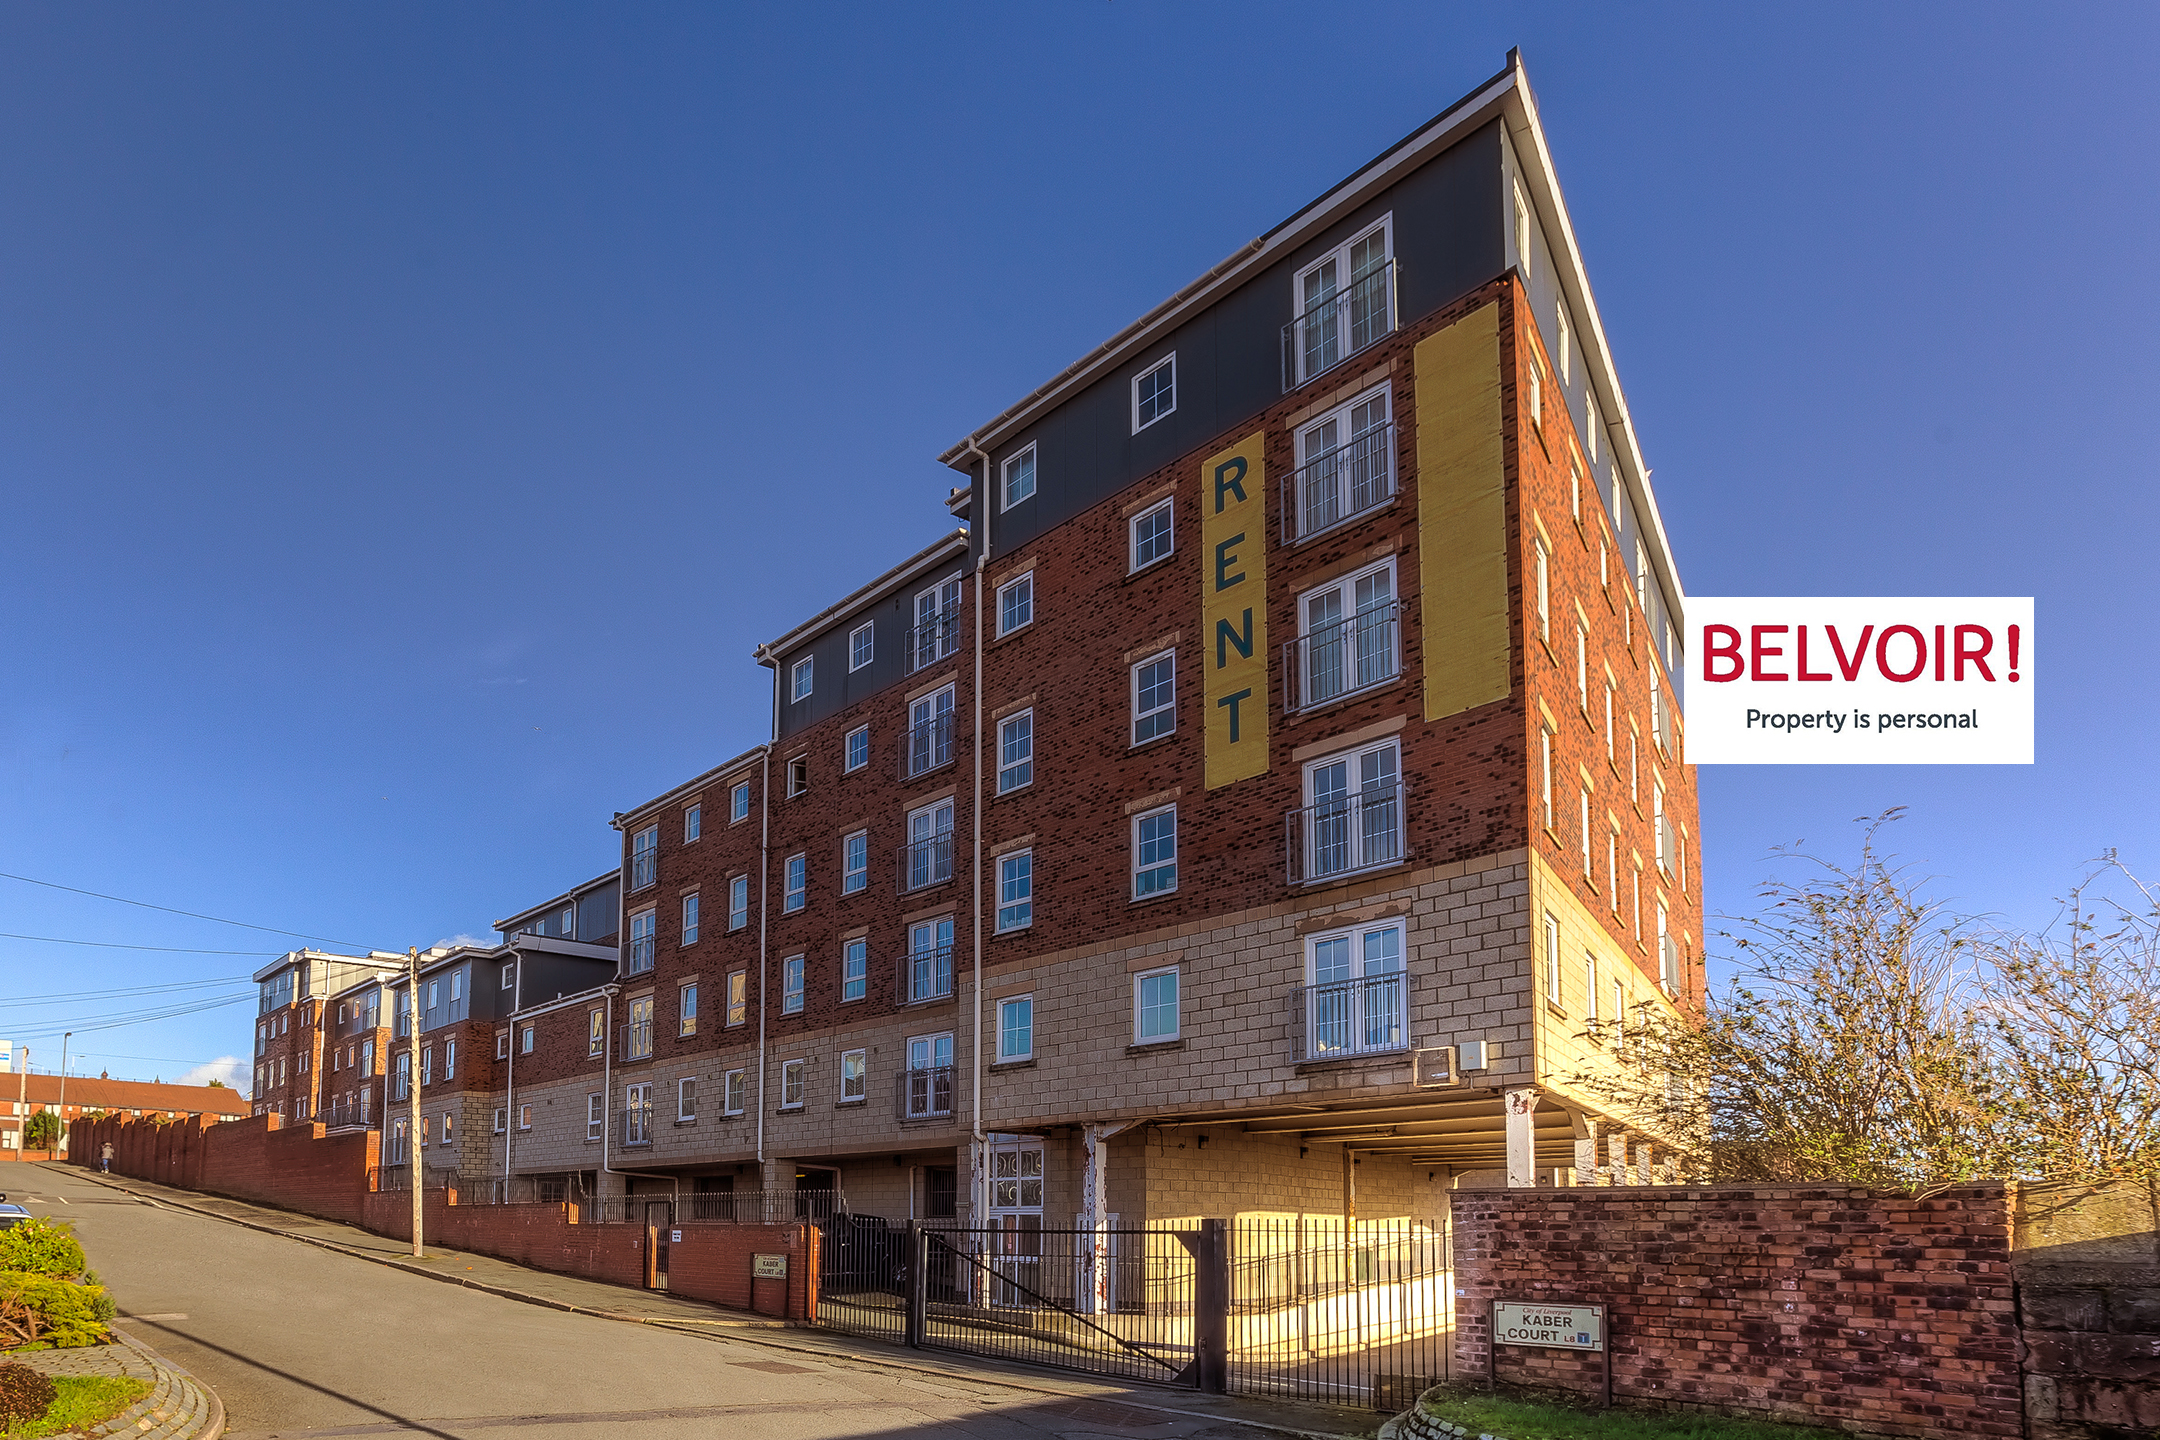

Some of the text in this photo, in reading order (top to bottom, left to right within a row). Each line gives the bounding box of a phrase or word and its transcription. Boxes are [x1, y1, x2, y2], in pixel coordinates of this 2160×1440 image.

[1214, 455, 1254, 745] RENT
[763, 1260, 779, 1268] KABER
[1522, 1307, 1534, 1315] City
[1543, 1308, 1573, 1316] Liverpool
[1522, 1314, 1573, 1328] KABER
[1507, 1328, 1576, 1343] COURT L8
